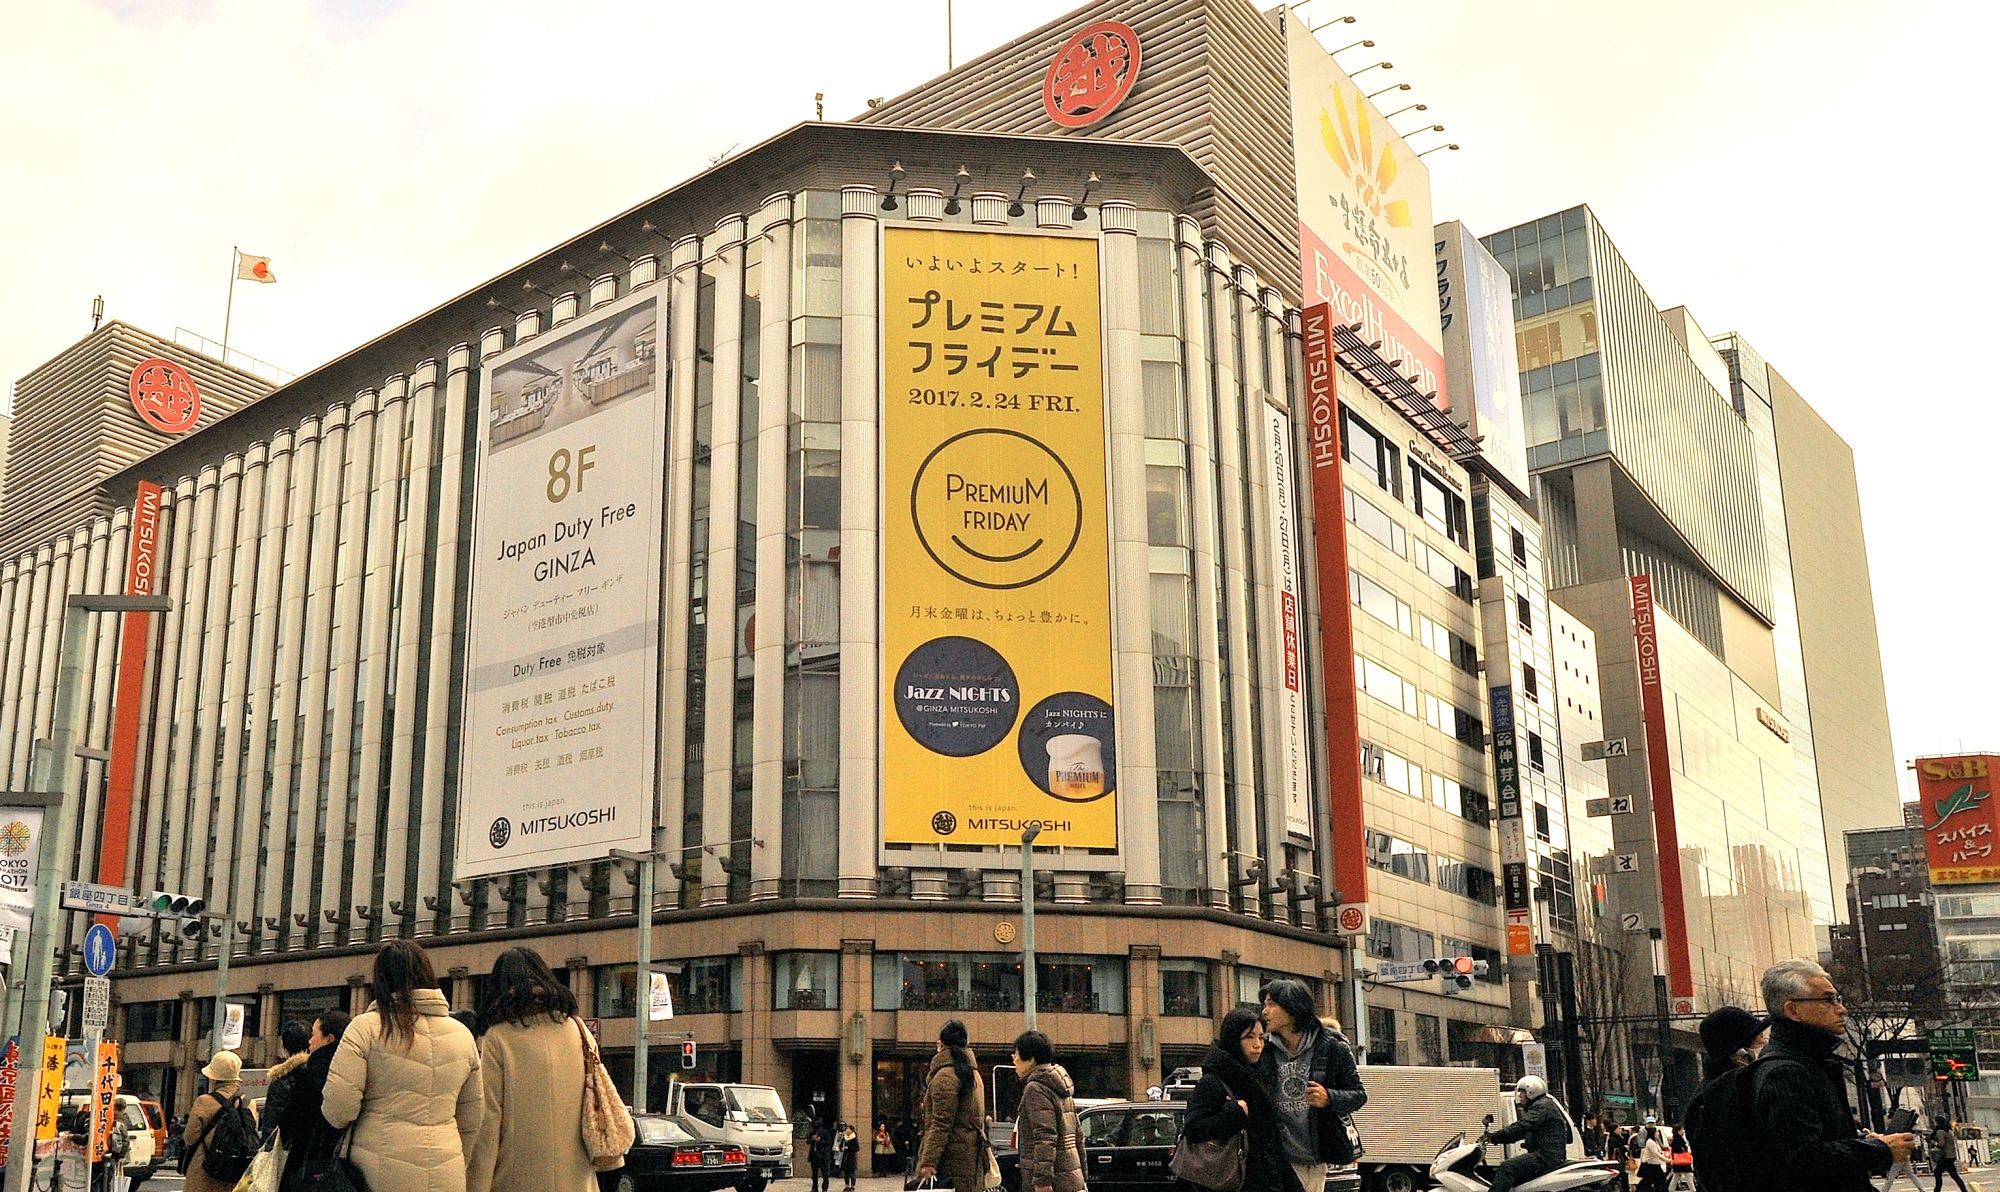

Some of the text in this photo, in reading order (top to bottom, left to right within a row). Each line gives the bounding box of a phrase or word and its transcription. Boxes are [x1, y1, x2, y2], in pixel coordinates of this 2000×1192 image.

[906, 255, 1078, 279] いよいよスタート!
[908, 290, 1077, 336] プレミアム
[908, 342, 1079, 378] フライデー
[1307, 315, 1334, 468] MITSUKOSHI
[1029, 394, 1080, 413] FRI.
[546, 444, 596, 503] 8F
[497, 503, 636, 561] Japan Duty Free
[964, 511, 1031, 531] FRIDAY
[134, 491, 158, 597] MITSUKOS
[534, 547, 596, 582] GINZA
[503, 574, 623, 620] ジャパン デューティー フリー ギンザ
[909, 605, 1089, 625] 月末金曜は、ちょっと豊かに。
[1635, 582, 1659, 687] MITSUKOSHI
[513, 642, 606, 678] Duty Free 免税対象
[502, 697, 529, 714] 消費税
[581, 675, 616, 695] たばこ税
[904, 685, 1010, 702] Jazz NIGHTS
[496, 702, 614, 737] Consumption tax Customs duty
[916, 705, 998, 714] @GINZA MITSUKOSHI
[1045, 709, 1060, 718] Jazz
[1062, 710, 1099, 719] NIGHTS
[511, 722, 602, 750] Liquor tax Tobacco tax
[1056, 771, 1099, 783] PREMIUM
[1499, 749, 1516, 800] 伸芽会
[1923, 758, 1988, 781] S&B
[522, 801, 536, 811] this
[537, 799, 544, 809] is
[969, 804, 983, 812] this
[985, 804, 993, 812] is
[520, 806, 616, 836] MITSUKOSHI
[969, 818, 1071, 831] MITSUKOSHI
[1964, 840, 1976, 849] &
[0, 859, 28, 868] OKYO
[0, 874, 28, 887] 017
[69, 888, 128, 906] 銀座四丁目
[86, 900, 103, 909] Ginza
